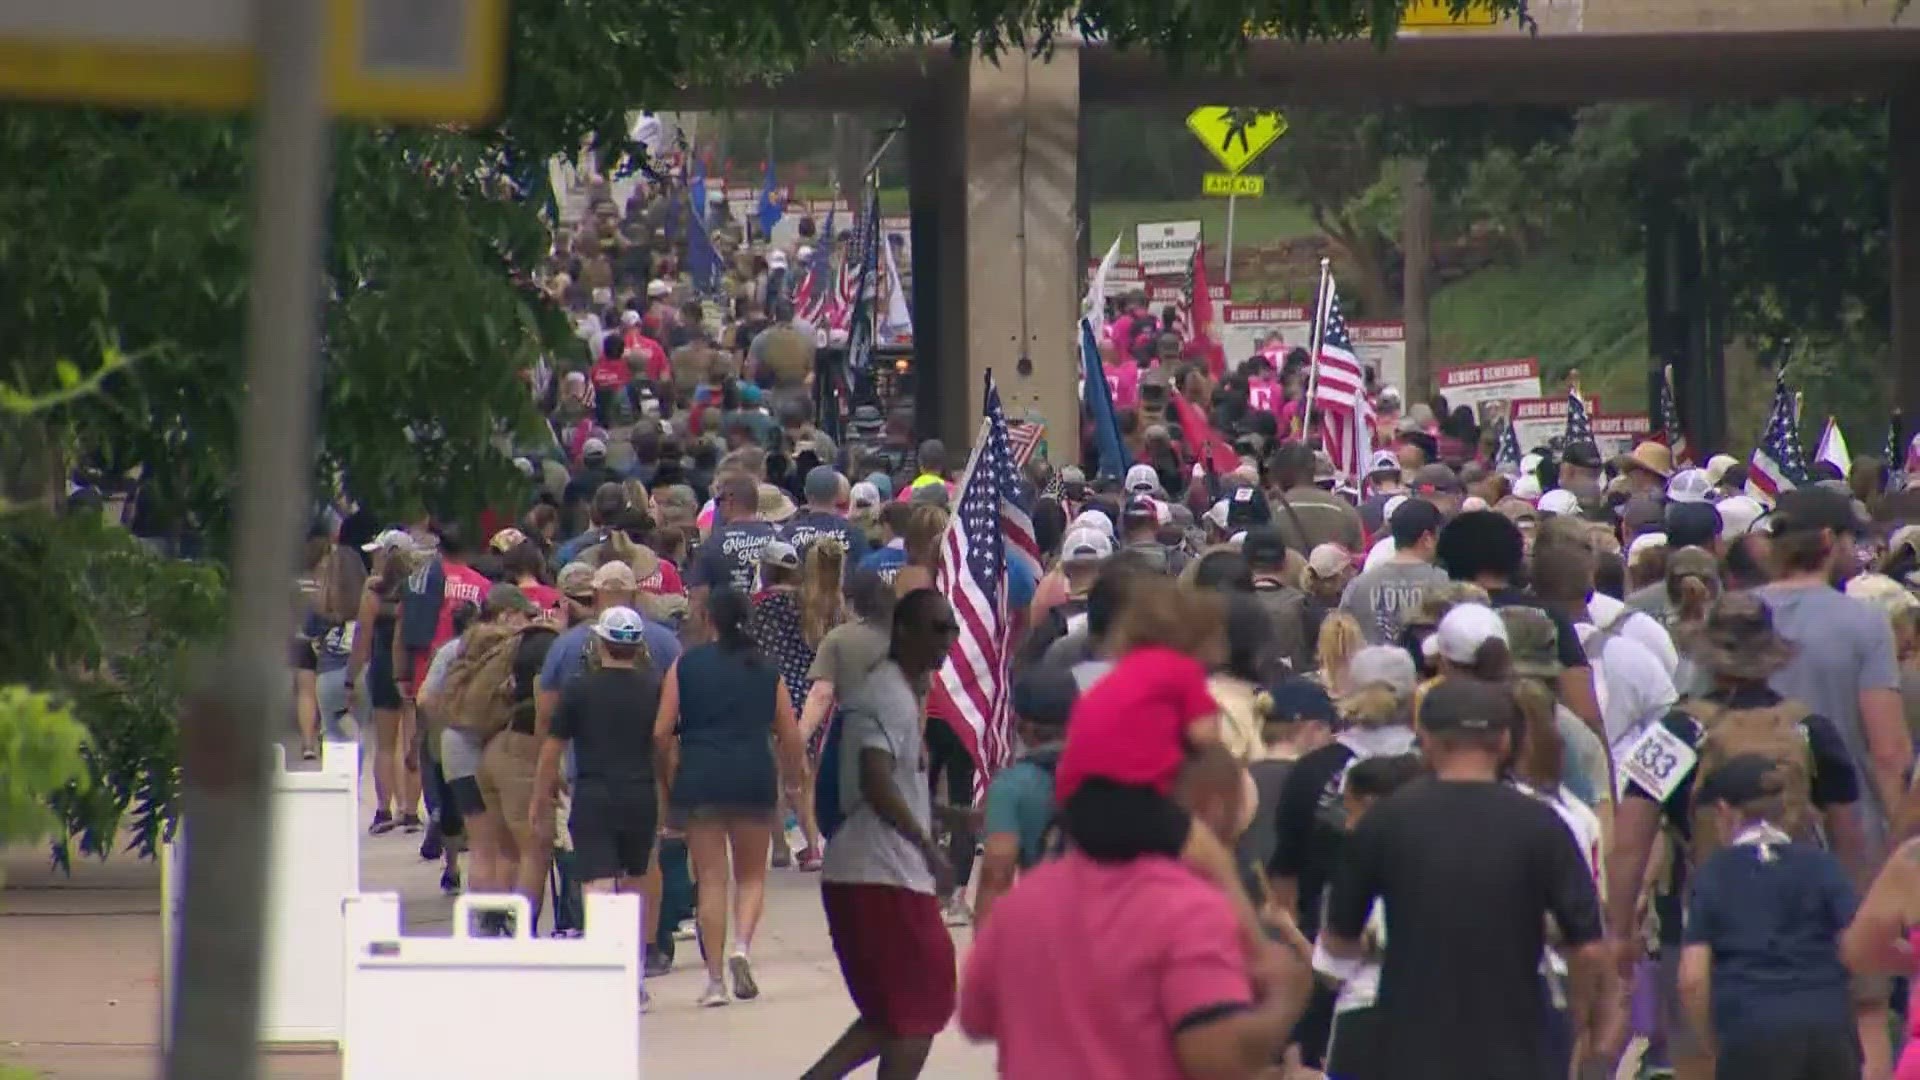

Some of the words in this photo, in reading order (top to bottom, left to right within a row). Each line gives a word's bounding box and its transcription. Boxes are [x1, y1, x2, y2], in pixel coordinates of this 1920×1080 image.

[1211, 178, 1258, 191] AHEAD
[1166, 239, 1195, 249] PARKIN
[1230, 308, 1259, 320] ALWAYS
[1447, 367, 1480, 384] ALWAYS
[1482, 363, 1531, 381] REMEMBER
[1518, 402, 1547, 417] ALWAYS
[1370, 586, 1422, 610] HONO
